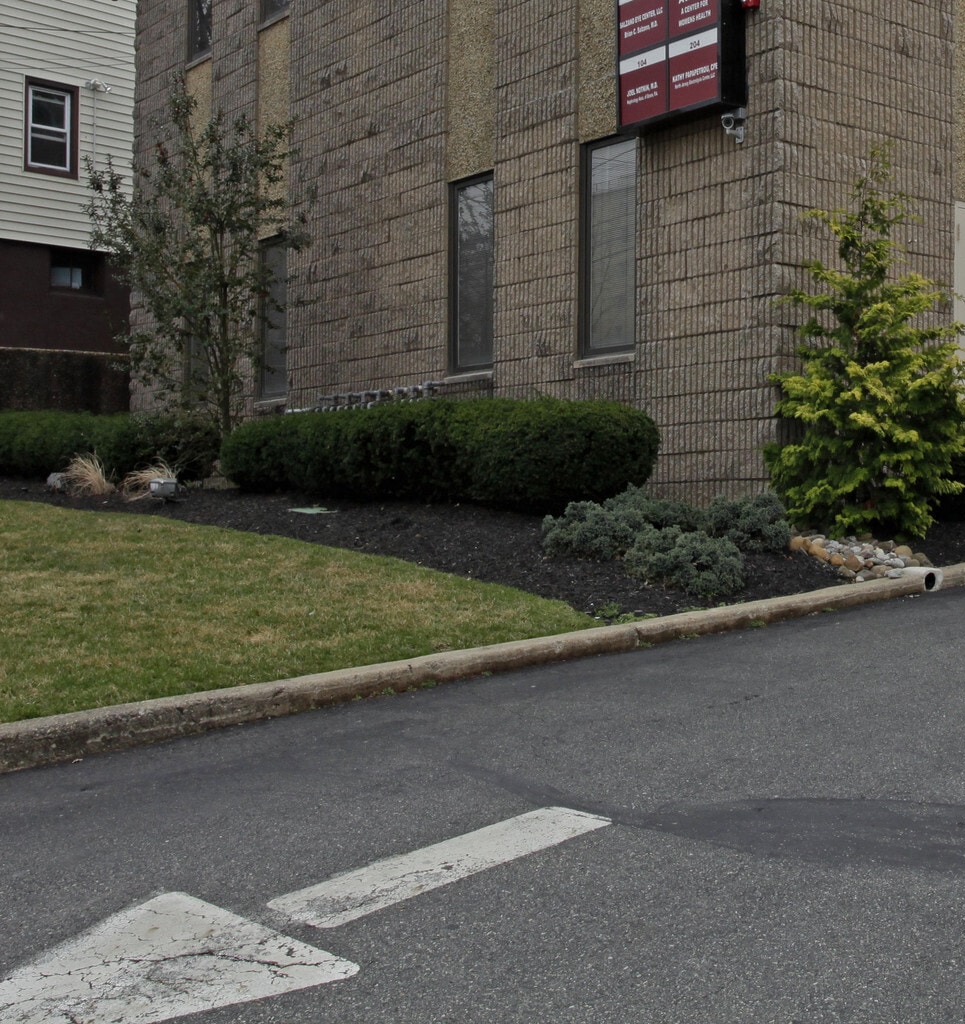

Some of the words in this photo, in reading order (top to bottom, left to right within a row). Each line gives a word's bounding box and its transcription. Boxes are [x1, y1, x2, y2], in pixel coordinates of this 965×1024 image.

[684, 2, 700, 12] CENTER
[696, 10, 712, 20] HEALTH
[690, 41, 701, 50] 204
